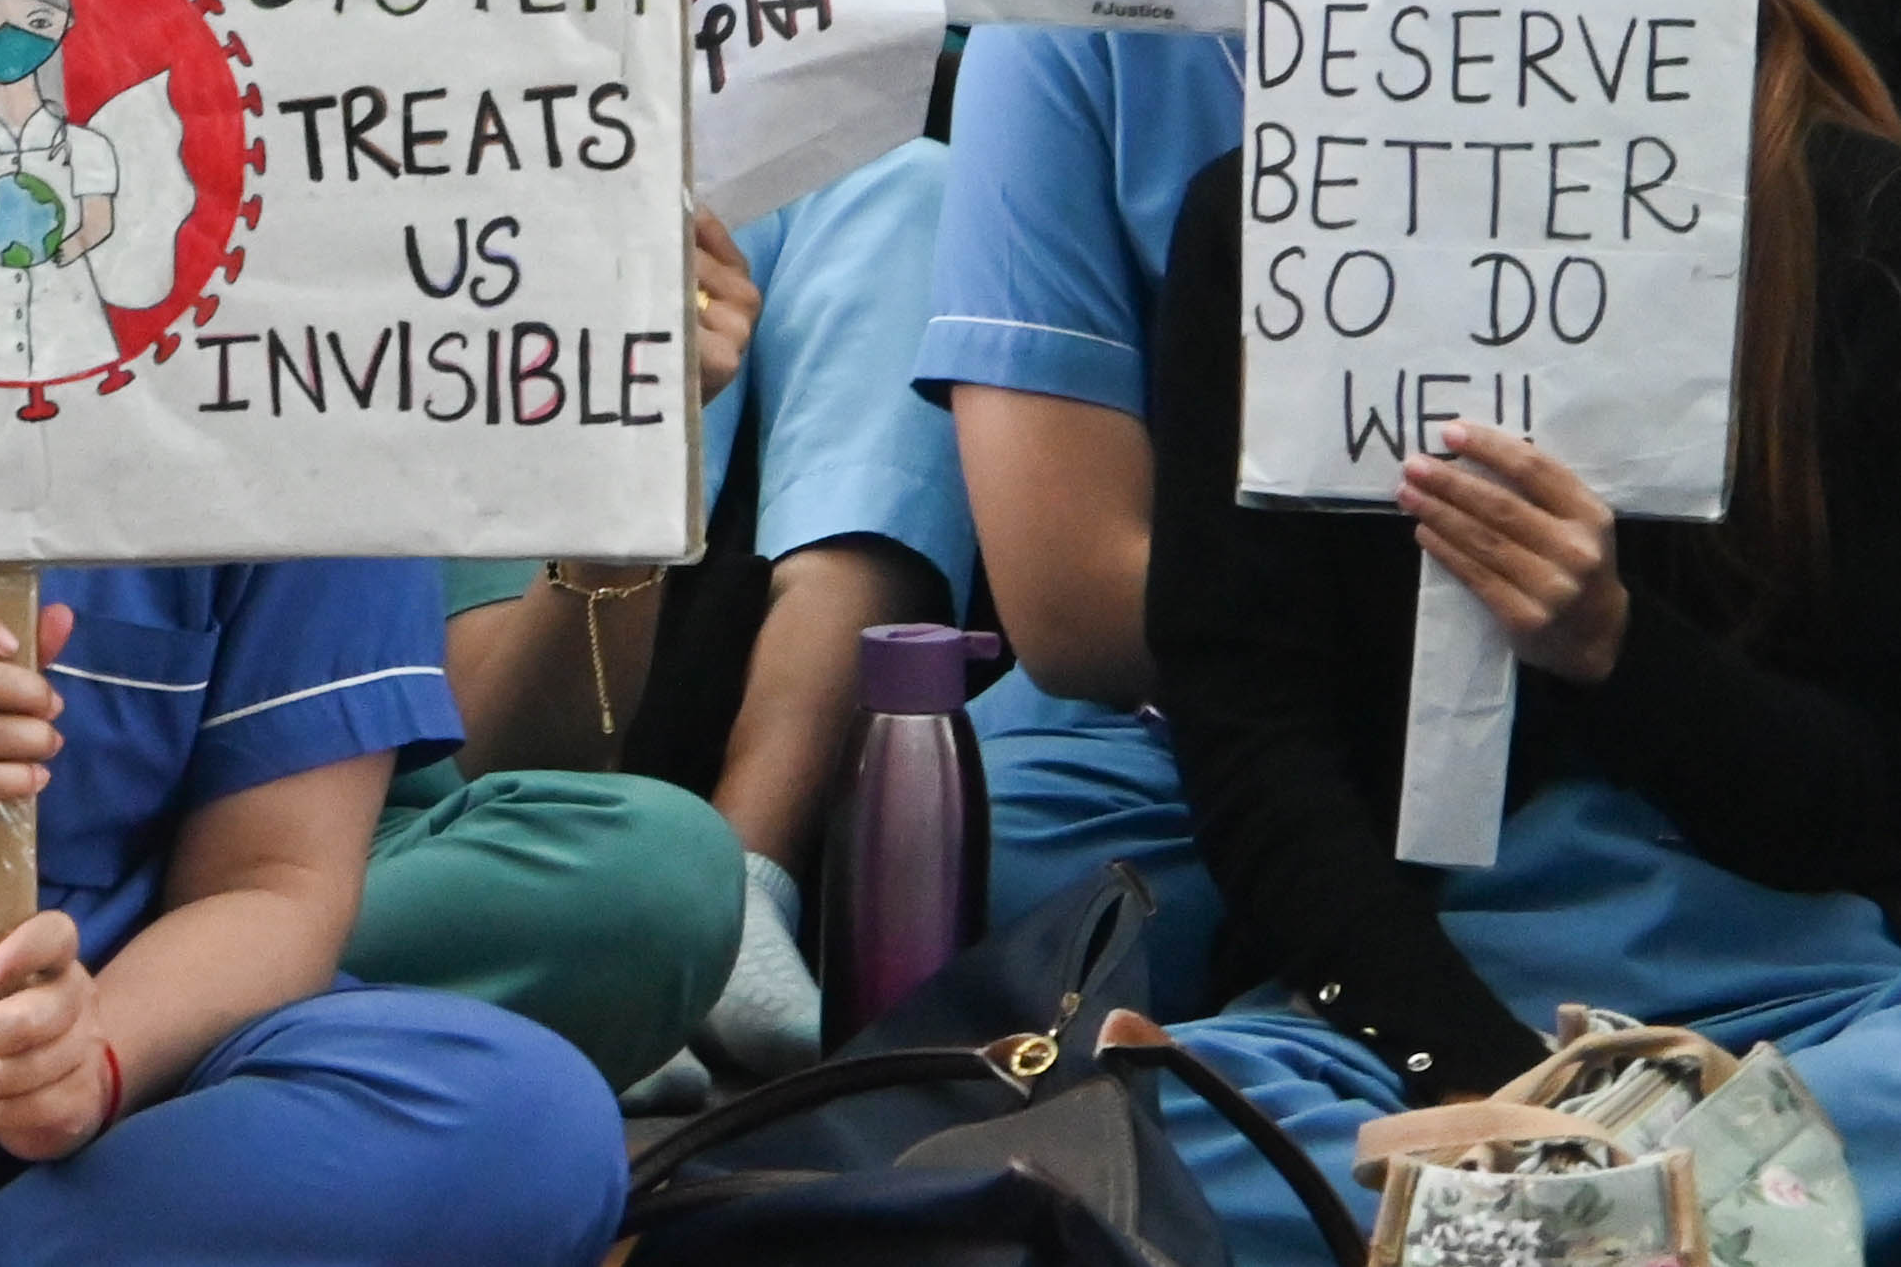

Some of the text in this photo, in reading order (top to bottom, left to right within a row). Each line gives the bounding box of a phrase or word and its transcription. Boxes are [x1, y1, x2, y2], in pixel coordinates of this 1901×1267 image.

[278, 81, 636, 183] TREATS
[1251, 121, 1700, 240] BETTER
[404, 216, 521, 308] US
[1254, 246, 1607, 346] SO DO
[196, 320, 672, 426] INVISIBLE
